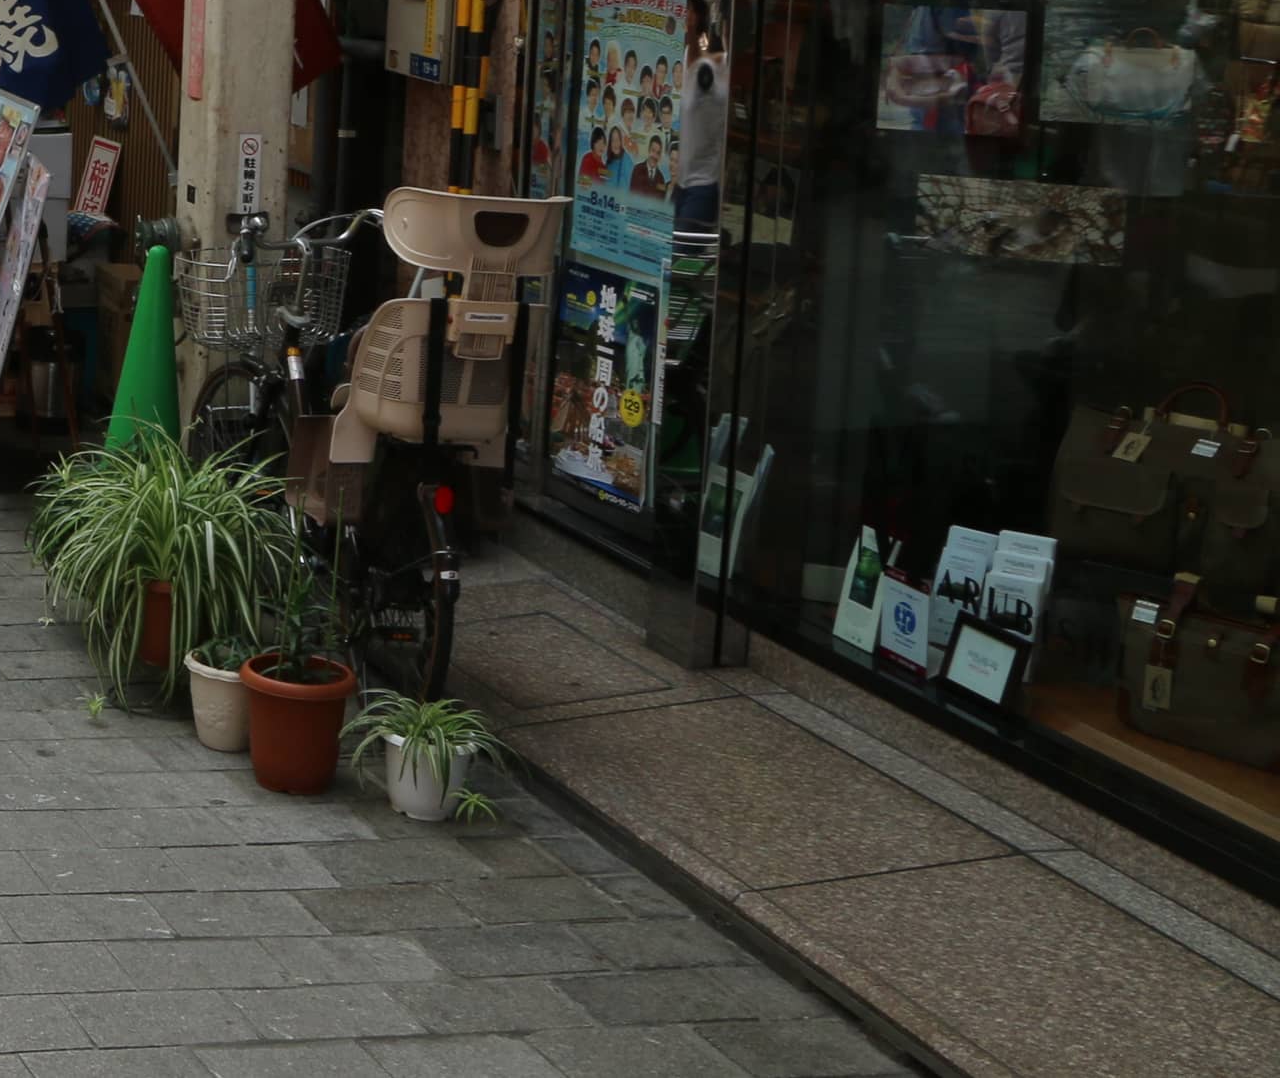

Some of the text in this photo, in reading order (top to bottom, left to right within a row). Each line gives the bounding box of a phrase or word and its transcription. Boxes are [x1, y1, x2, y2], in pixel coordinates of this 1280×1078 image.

[587, 284, 617, 472] 地球一周の船旅
